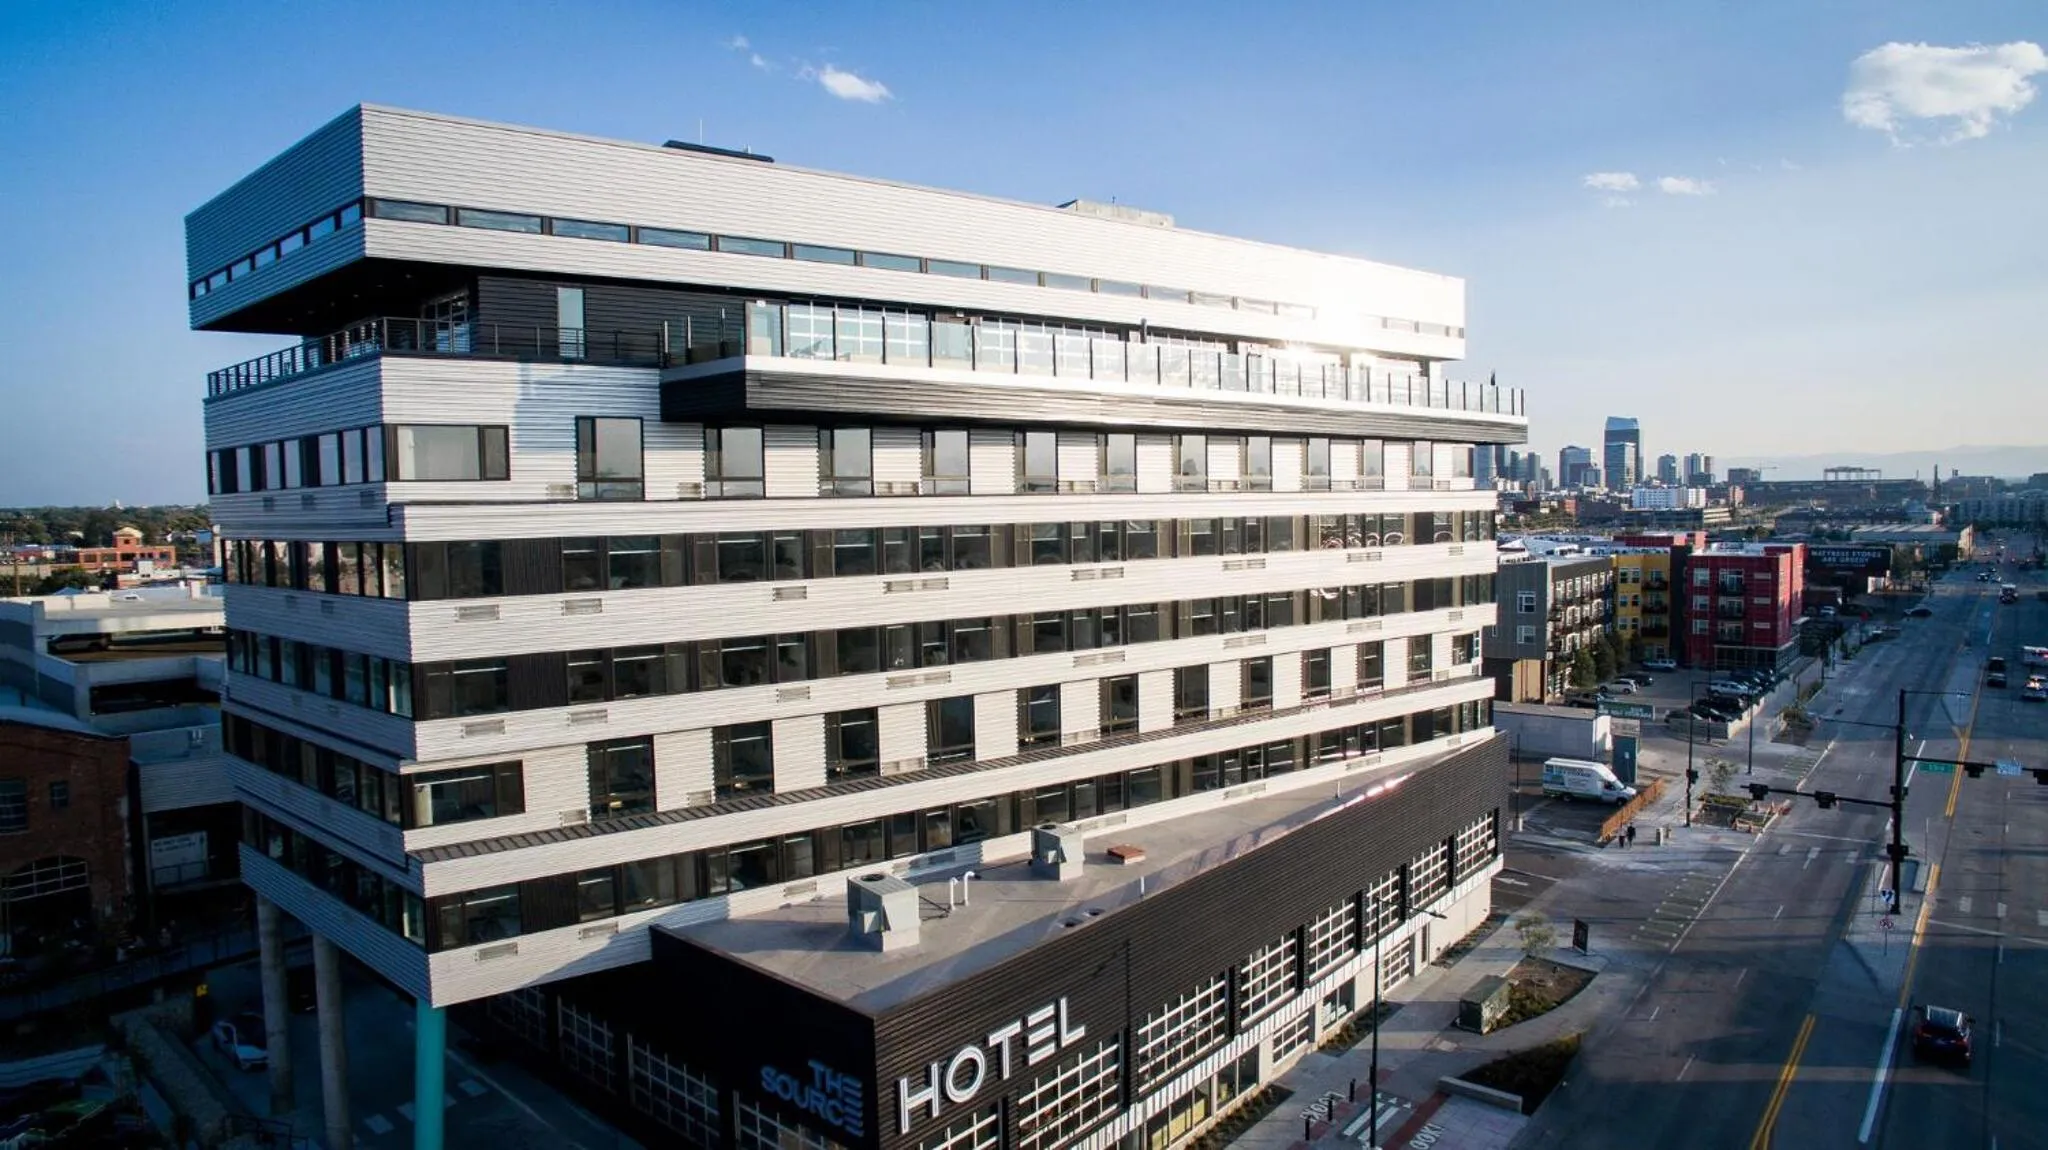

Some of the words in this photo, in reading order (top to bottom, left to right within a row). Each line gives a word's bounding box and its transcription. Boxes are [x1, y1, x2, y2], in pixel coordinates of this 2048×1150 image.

[807, 1058, 864, 1108] THE
[899, 997, 1085, 1135] HOTEL
[759, 1064, 865, 1138] SOURCE
[1409, 1122, 1445, 1150] OOK!
